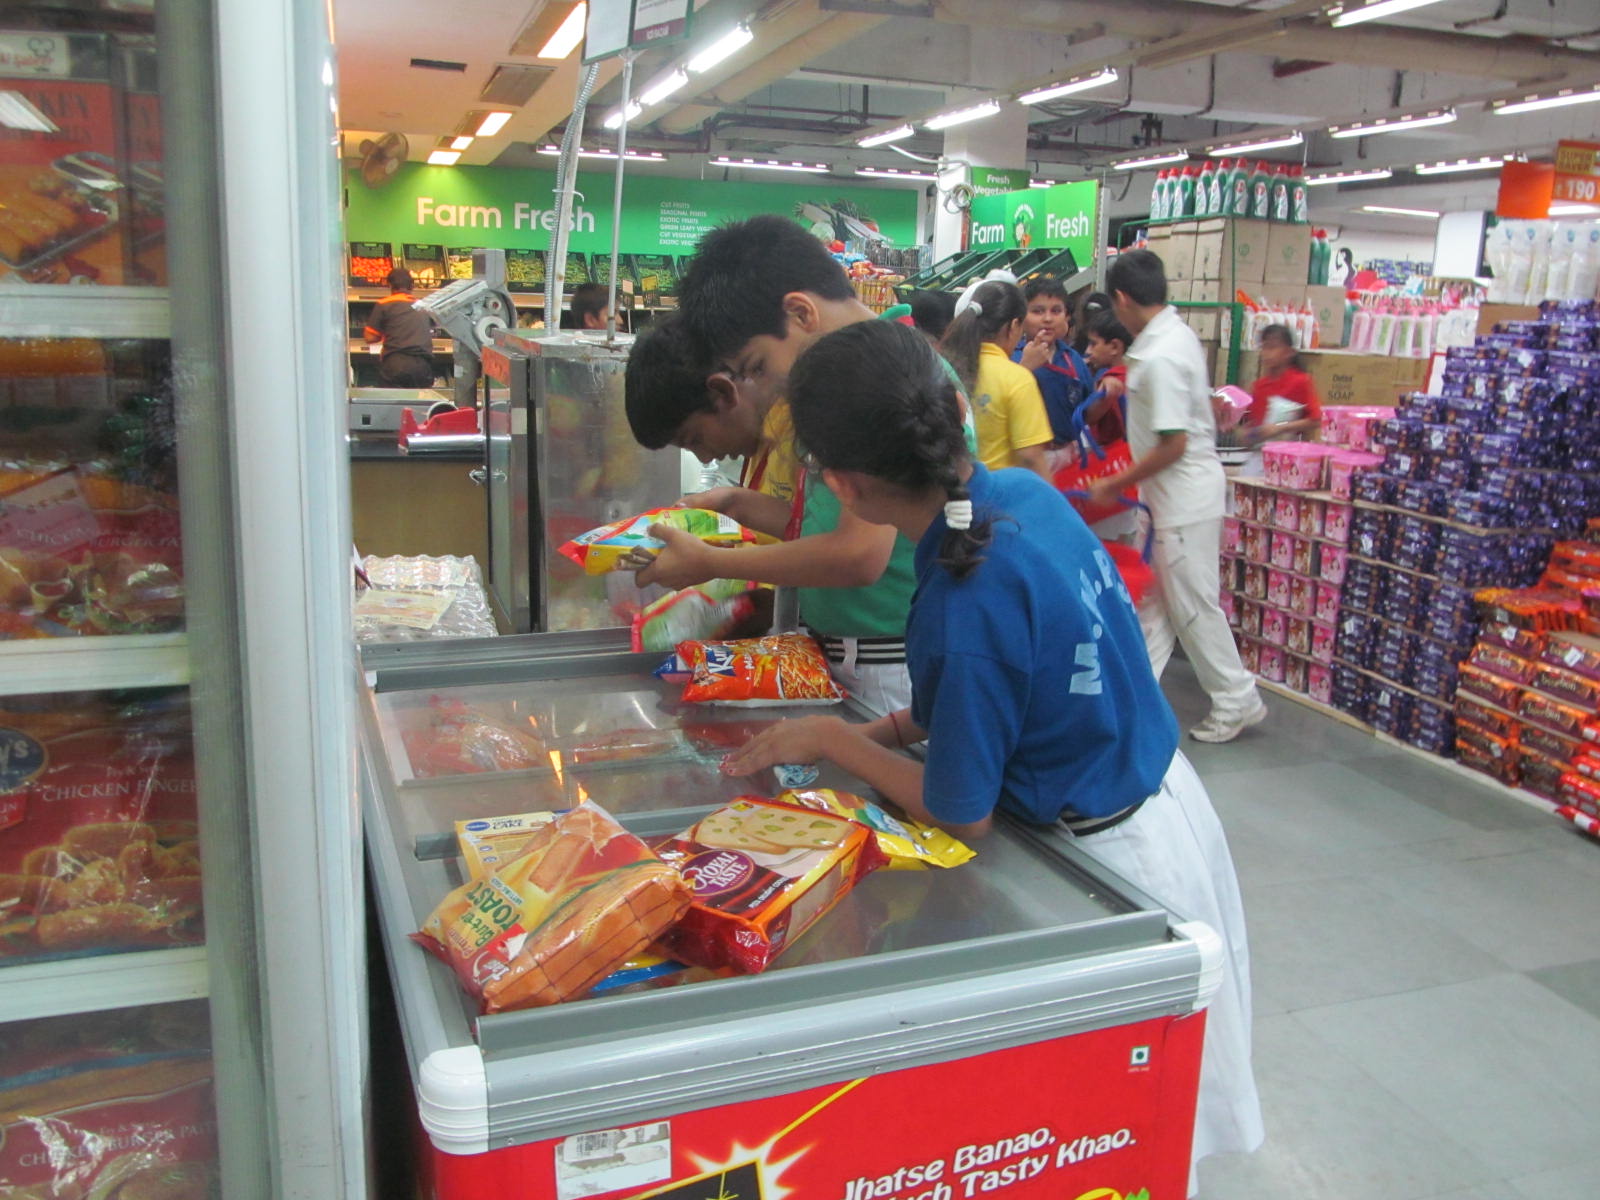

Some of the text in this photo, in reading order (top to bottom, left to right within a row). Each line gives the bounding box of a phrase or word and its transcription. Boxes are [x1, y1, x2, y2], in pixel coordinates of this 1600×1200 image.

[986, 174, 1010, 185] Fresh
[416, 197, 502, 229] Farm
[971, 222, 1004, 245] Farm
[1046, 211, 1089, 239] Fresh
[42, 781, 131, 803] CHICKEN
[681, 851, 739, 891] ROYAL
[708, 862, 749, 888] TASTE
[953, 1127, 1056, 1174] Banao,
[959, 1153, 1050, 1198] Tasty
[1055, 1128, 1137, 1169] Khao.
